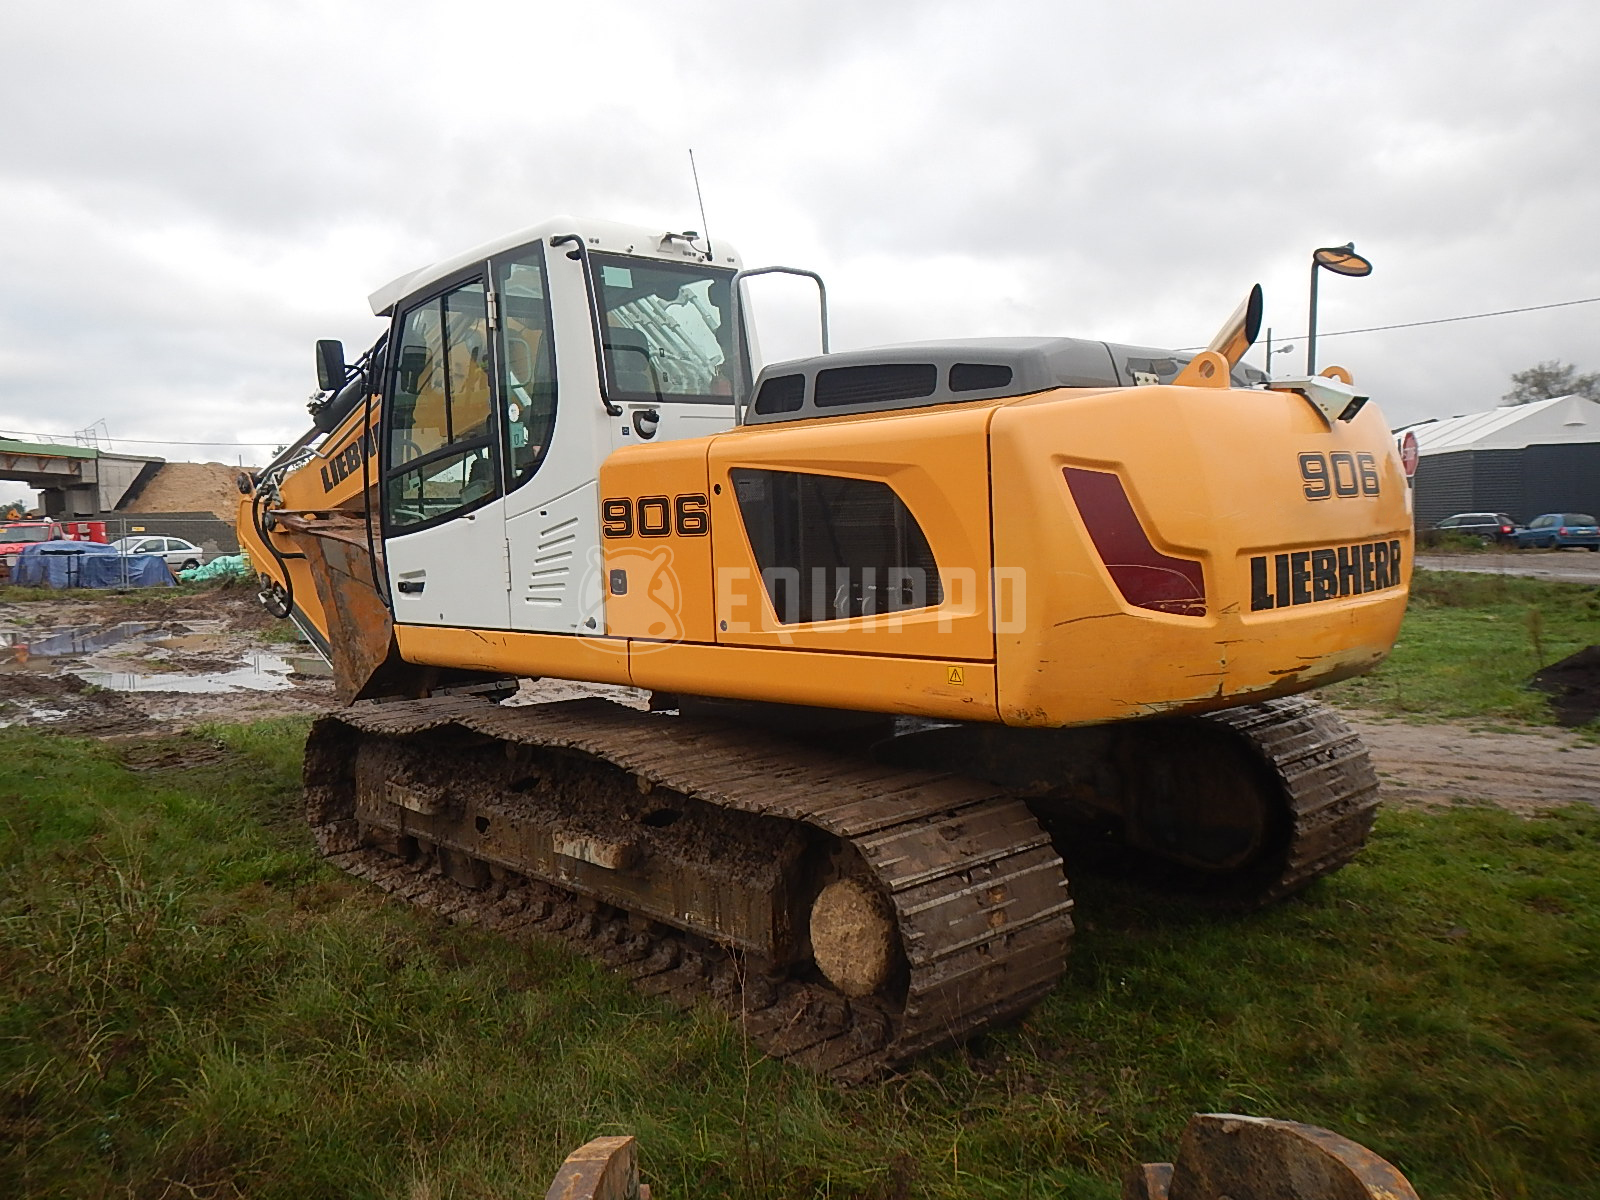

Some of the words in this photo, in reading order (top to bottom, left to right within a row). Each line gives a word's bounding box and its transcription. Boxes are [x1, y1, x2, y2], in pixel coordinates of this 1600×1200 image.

[1297, 451, 1380, 501] 906
[602, 493, 709, 539] 906
[1250, 540, 1401, 612] LIEBHERR
